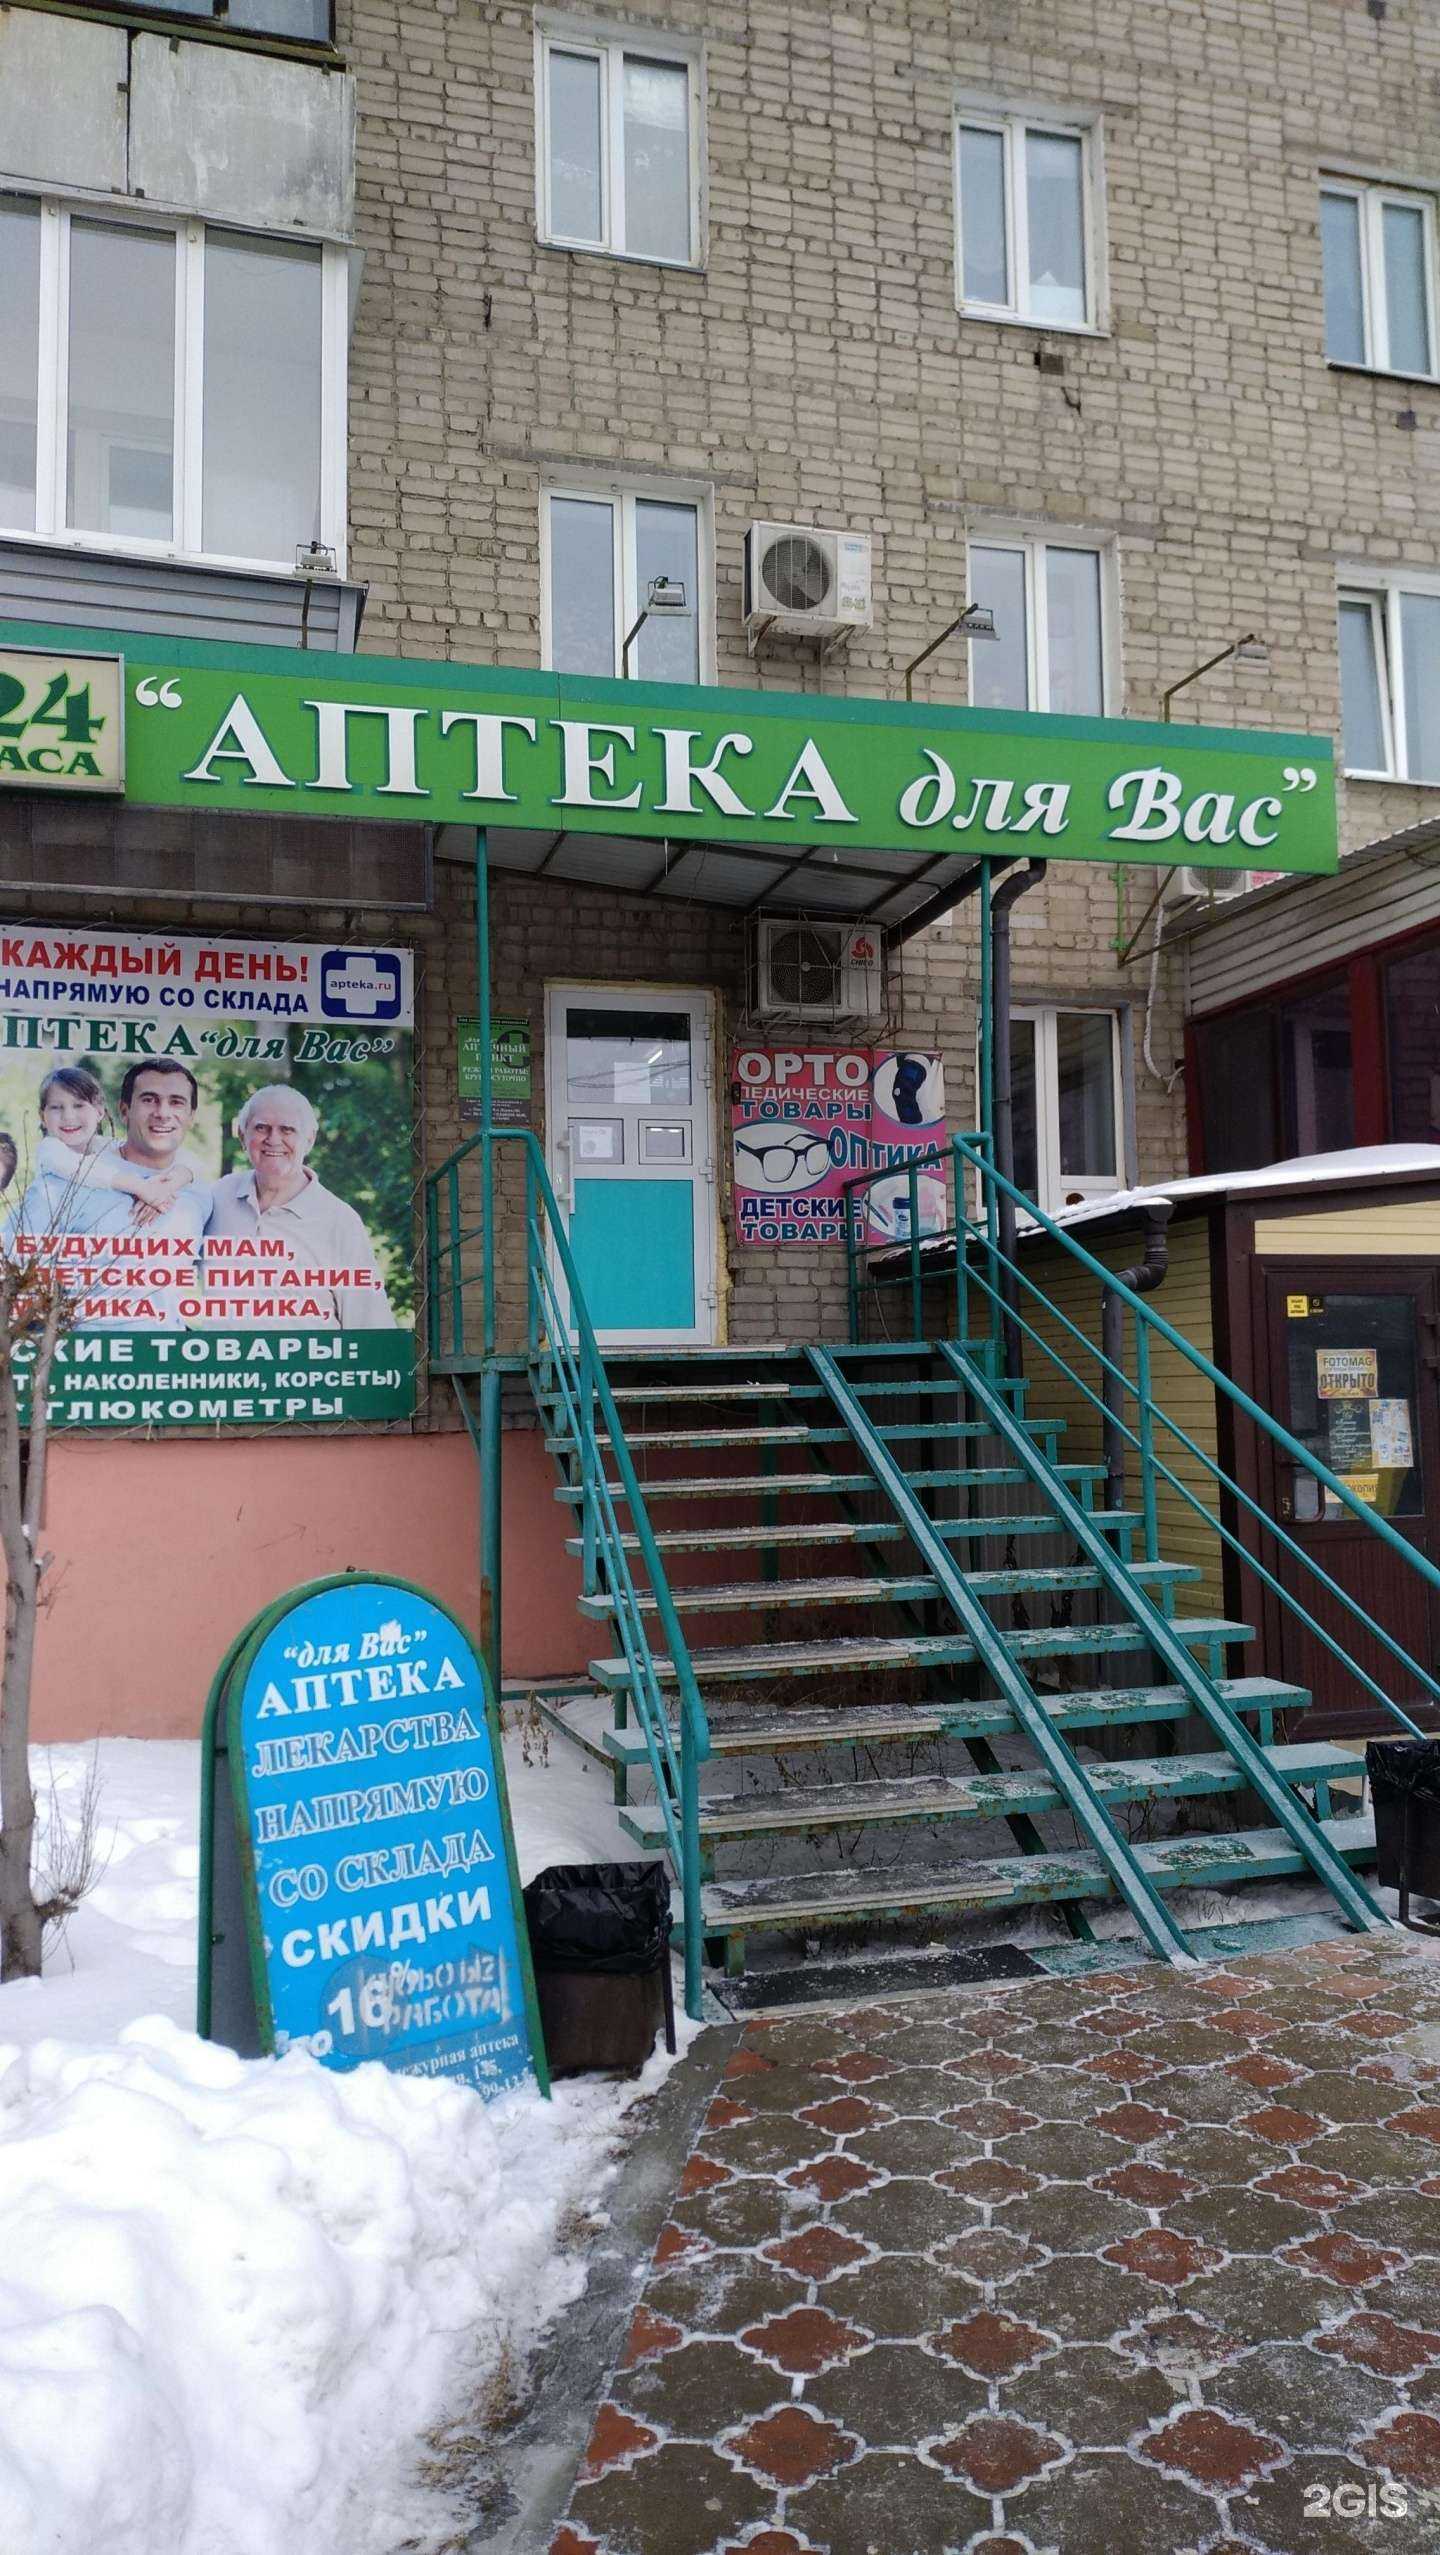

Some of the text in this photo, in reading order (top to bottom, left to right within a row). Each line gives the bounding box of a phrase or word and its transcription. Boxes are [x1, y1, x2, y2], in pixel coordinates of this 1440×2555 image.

[898, 747, 1071, 835] для
[1107, 766, 1318, 847] Вас”
[2, 938, 309, 983] КАЖДЫЙ ДЕНЬ!
[0, 978, 309, 1016] НАПРЯМУЮ СО СКЛАДА
[329, 979, 393, 993] apteka.ru
[737, 1052, 870, 1087] ОРТО
[739, 1101, 872, 1121] ТОВАРЫ
[828, 1125, 944, 1172] ОПТИКА
[740, 1196, 864, 1222] ДЕТСКИЕ
[742, 1221, 866, 1242] ТОВАРЫ
[16, 1235, 296, 1261] БУДУЩИХ МАМ,
[207, 1268, 383, 1290] ПИТАНИЕ,
[179, 1298, 331, 1321] ОПТИКА,
[151, 1337, 359, 1362] ТОВАРЫ:
[1323, 1356, 1373, 1368] FOTOMAG
[64, 1373, 267, 1393] НАКОЛЕННИКИ,
[275, 1370, 402, 1389] КОРСЕТЫ)
[1320, 1372, 1375, 1390] ОТКРЫТО
[46, 1397, 343, 1420] ГЛЮКОМЕТРЫ
[256, 1656, 465, 1719] АПТЕКА
[252, 1707, 481, 1778] ЛЕКАРСТВА
[255, 1766, 489, 1843] НАПРЯМУЮ
[269, 1829, 495, 1907] СО СКЛАДА
[281, 1885, 492, 1968] СКИДКИ
